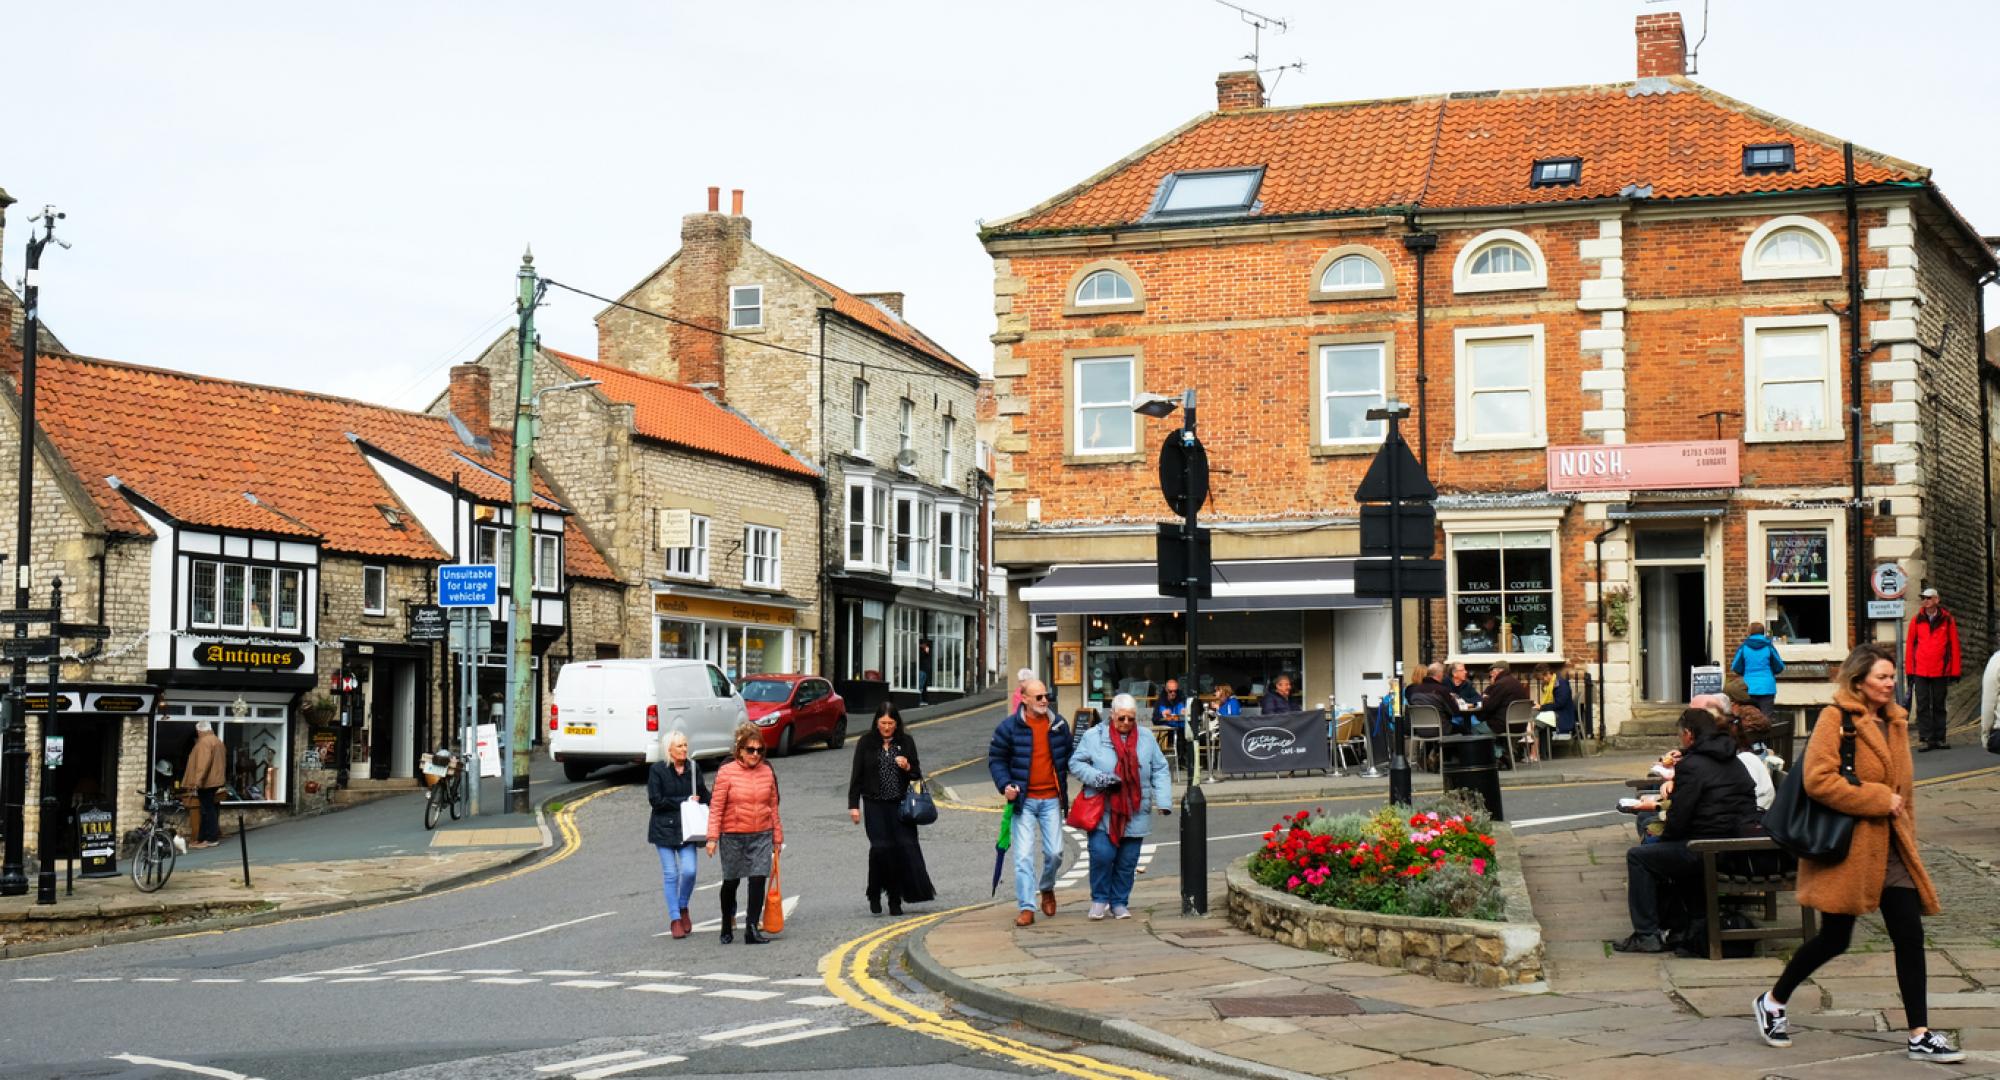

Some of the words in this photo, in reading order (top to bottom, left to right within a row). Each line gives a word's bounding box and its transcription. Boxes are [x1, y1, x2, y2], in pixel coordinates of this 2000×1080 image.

[1559, 449, 1632, 477] NOSH.
[443, 569, 493, 580] Unsuitable
[447, 581, 462, 591] for
[464, 581, 488, 592] large
[1467, 581, 1490, 590] TEAS
[1510, 581, 1543, 589] COFFEE
[448, 591, 486, 602] vehicles
[1514, 595, 1540, 604] LIGHT
[1465, 605, 1491, 613] CAKES
[1508, 603, 1547, 612] LUNCHES
[207, 645, 293, 667] Antiques
